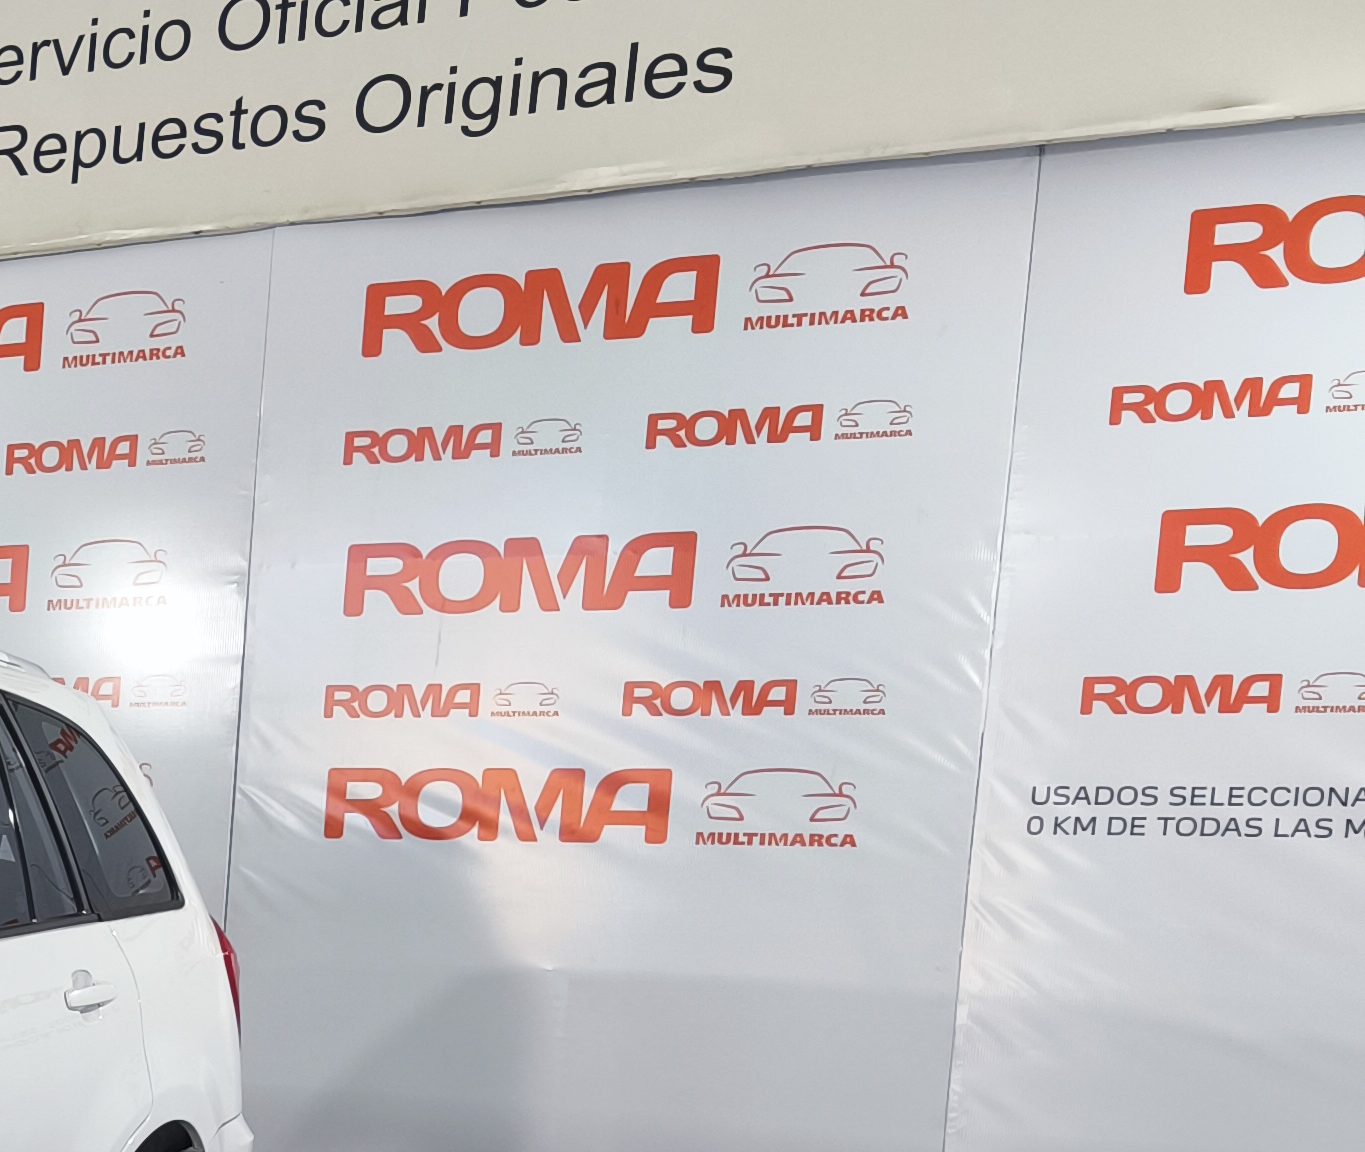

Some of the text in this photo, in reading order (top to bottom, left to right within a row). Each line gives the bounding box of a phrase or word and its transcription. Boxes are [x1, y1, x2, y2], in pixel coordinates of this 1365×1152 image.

[356, 42, 732, 137] Originales
[363, 255, 721, 358] ROMA
[743, 305, 909, 331] MULTIMARCA
[62, 346, 186, 369] MULTIMARCA
[1110, 375, 1313, 426] ROMA
[647, 405, 823, 449] ROMA
[834, 429, 913, 440] MULTIMARCA
[7, 436, 138, 475] ROMA
[145, 455, 206, 467] MULTIMARCA
[345, 424, 502, 465] ROMA
[512, 447, 582, 457] MULTIMARCA
[1155, 505, 1365, 594] RO
[345, 533, 697, 616] ROMA
[720, 590, 885, 608] MULTIMARCA
[325, 685, 481, 718] ROMA
[623, 681, 797, 716] ROMA
[1081, 675, 1283, 715] ROMA
[809, 708, 886, 717] MULTIMARCA
[325, 769, 673, 845] ROMA
[1031, 786, 1158, 806] USADOS
[695, 831, 857, 848] MULTIMARCA
[1053, 816, 1096, 836] KM
[1107, 817, 1147, 836] DE
[1157, 817, 1262, 837] TODAS
[1273, 818, 1332, 839] LAS
